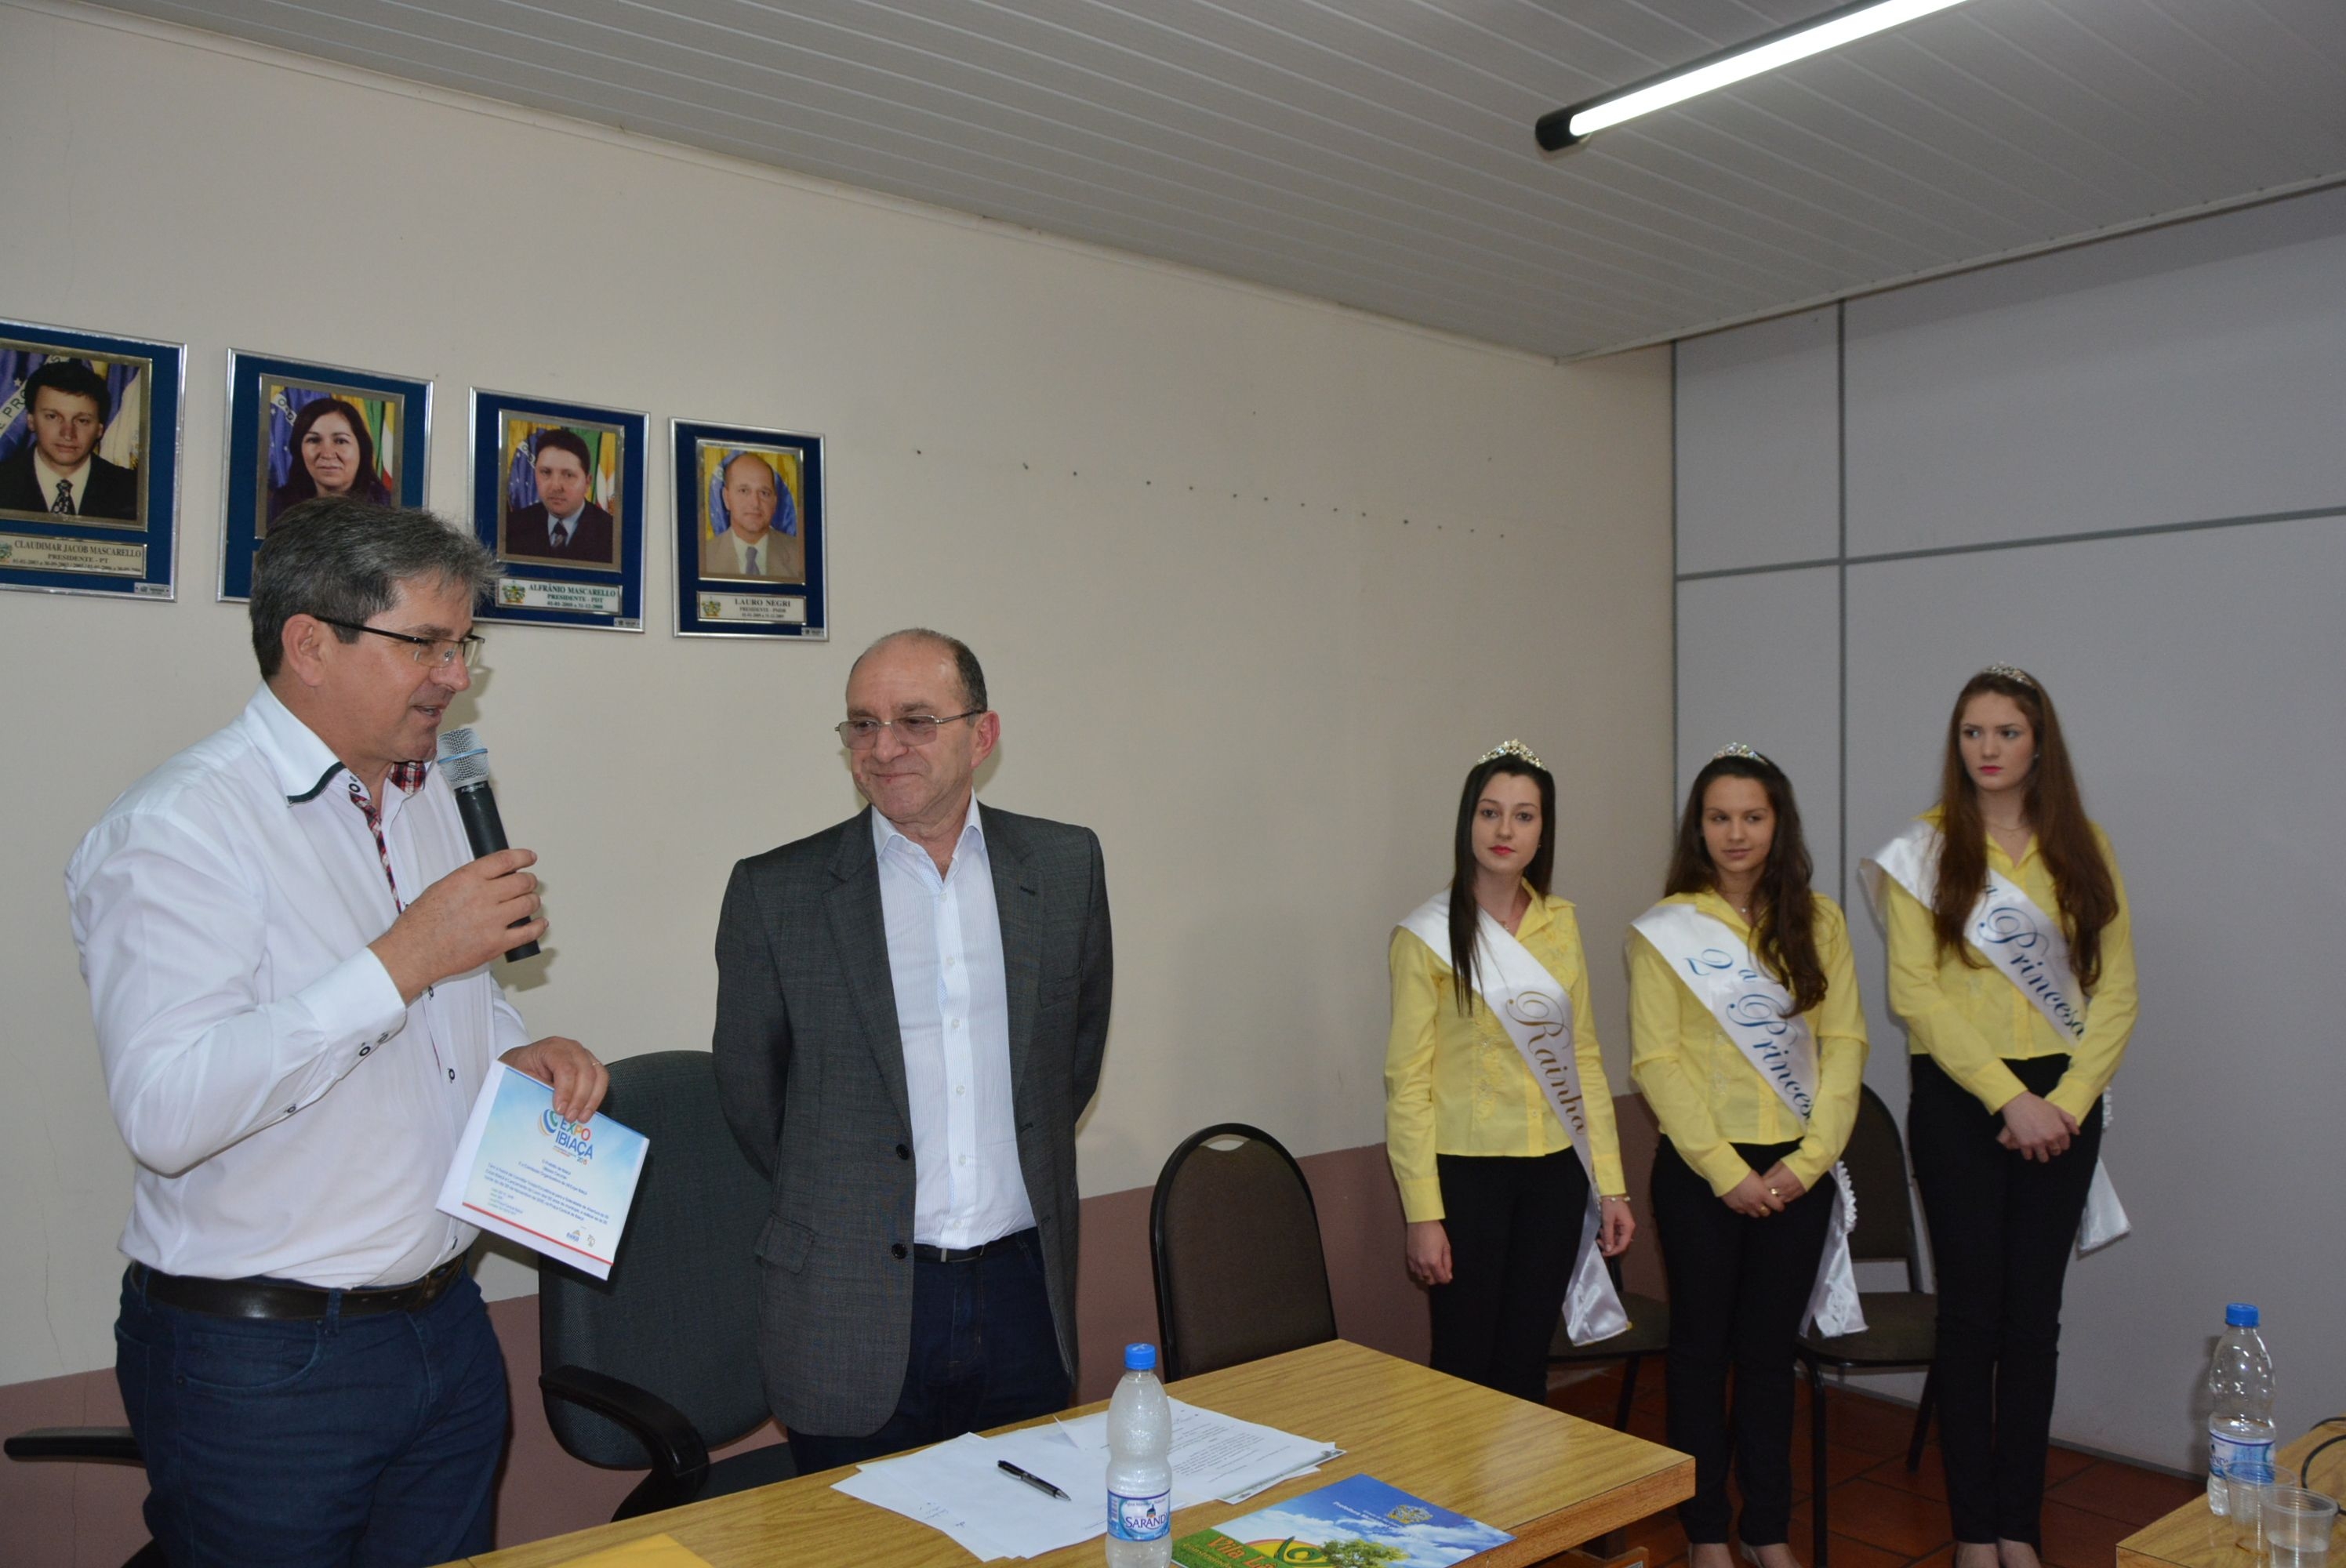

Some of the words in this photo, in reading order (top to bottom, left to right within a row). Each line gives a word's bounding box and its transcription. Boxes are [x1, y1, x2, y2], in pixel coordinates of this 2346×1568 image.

[14, 539, 62, 551] CLAUDIMAR
[64, 544, 89, 554] JACOB
[90, 546, 142, 557] MASCARELLO
[48, 554, 95, 563] PRESIDENTE
[528, 583, 565, 593] ALFRÂNIO
[566, 586, 616, 597] MASCARELLO
[547, 593, 586, 602] PRESIDENTE
[1977, 907, 2085, 1041] Princesa
[1505, 991, 1585, 1135] Rainha
[560, 1117, 591, 1142] EXPO
[1208, 1536, 1245, 1560] Vila
